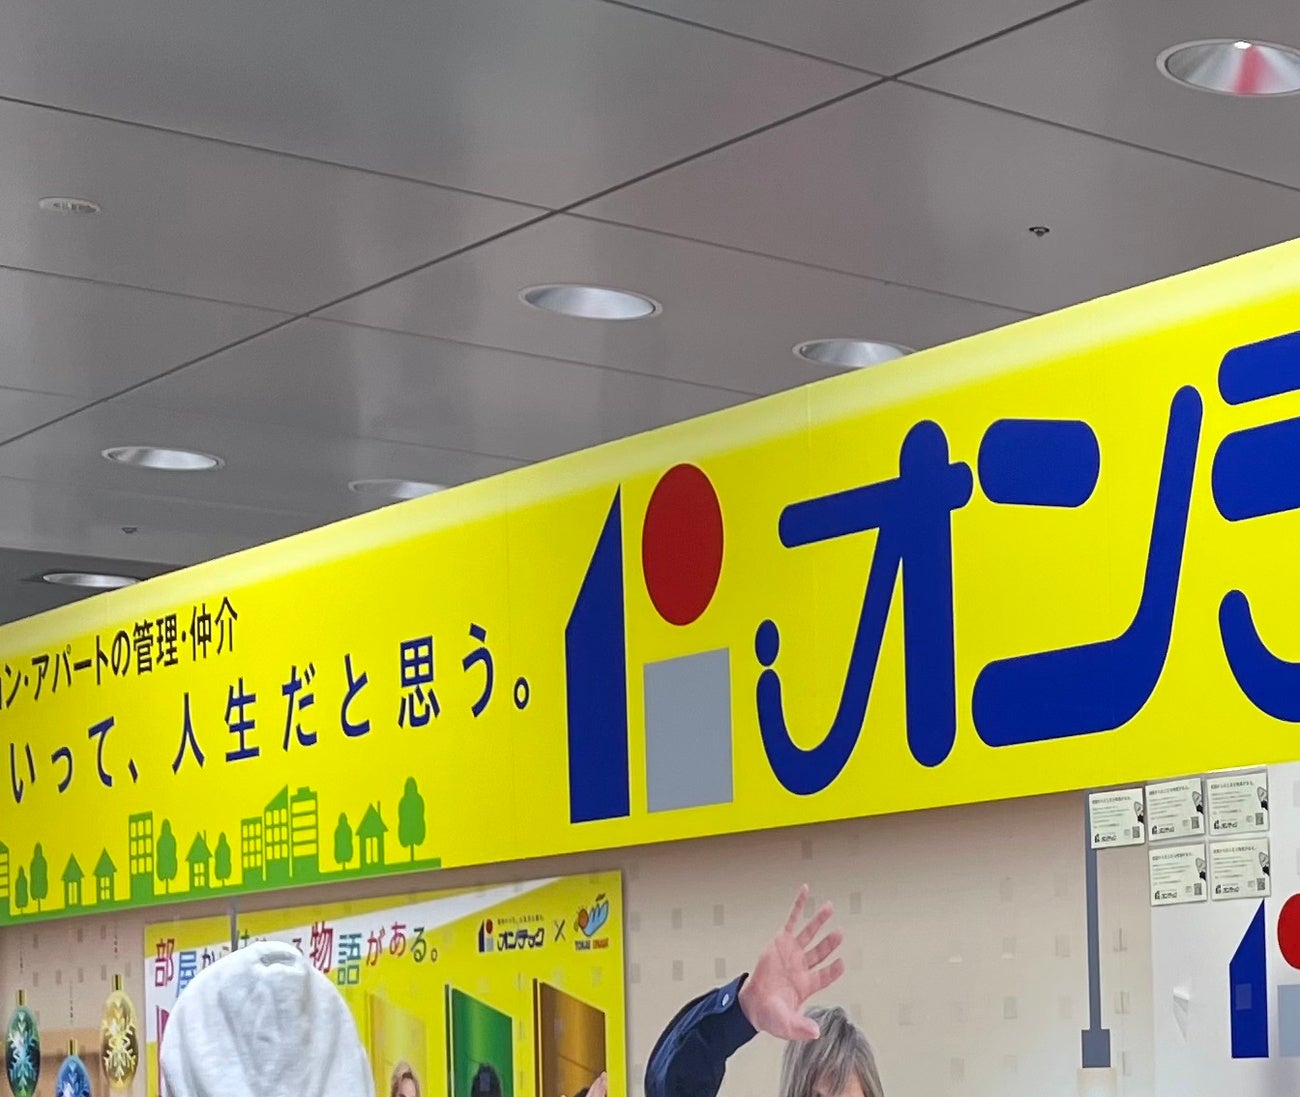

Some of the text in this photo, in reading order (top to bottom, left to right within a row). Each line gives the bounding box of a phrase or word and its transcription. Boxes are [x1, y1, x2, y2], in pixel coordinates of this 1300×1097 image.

[0, 597, 238, 709] ン・アパートの管理・仲介
